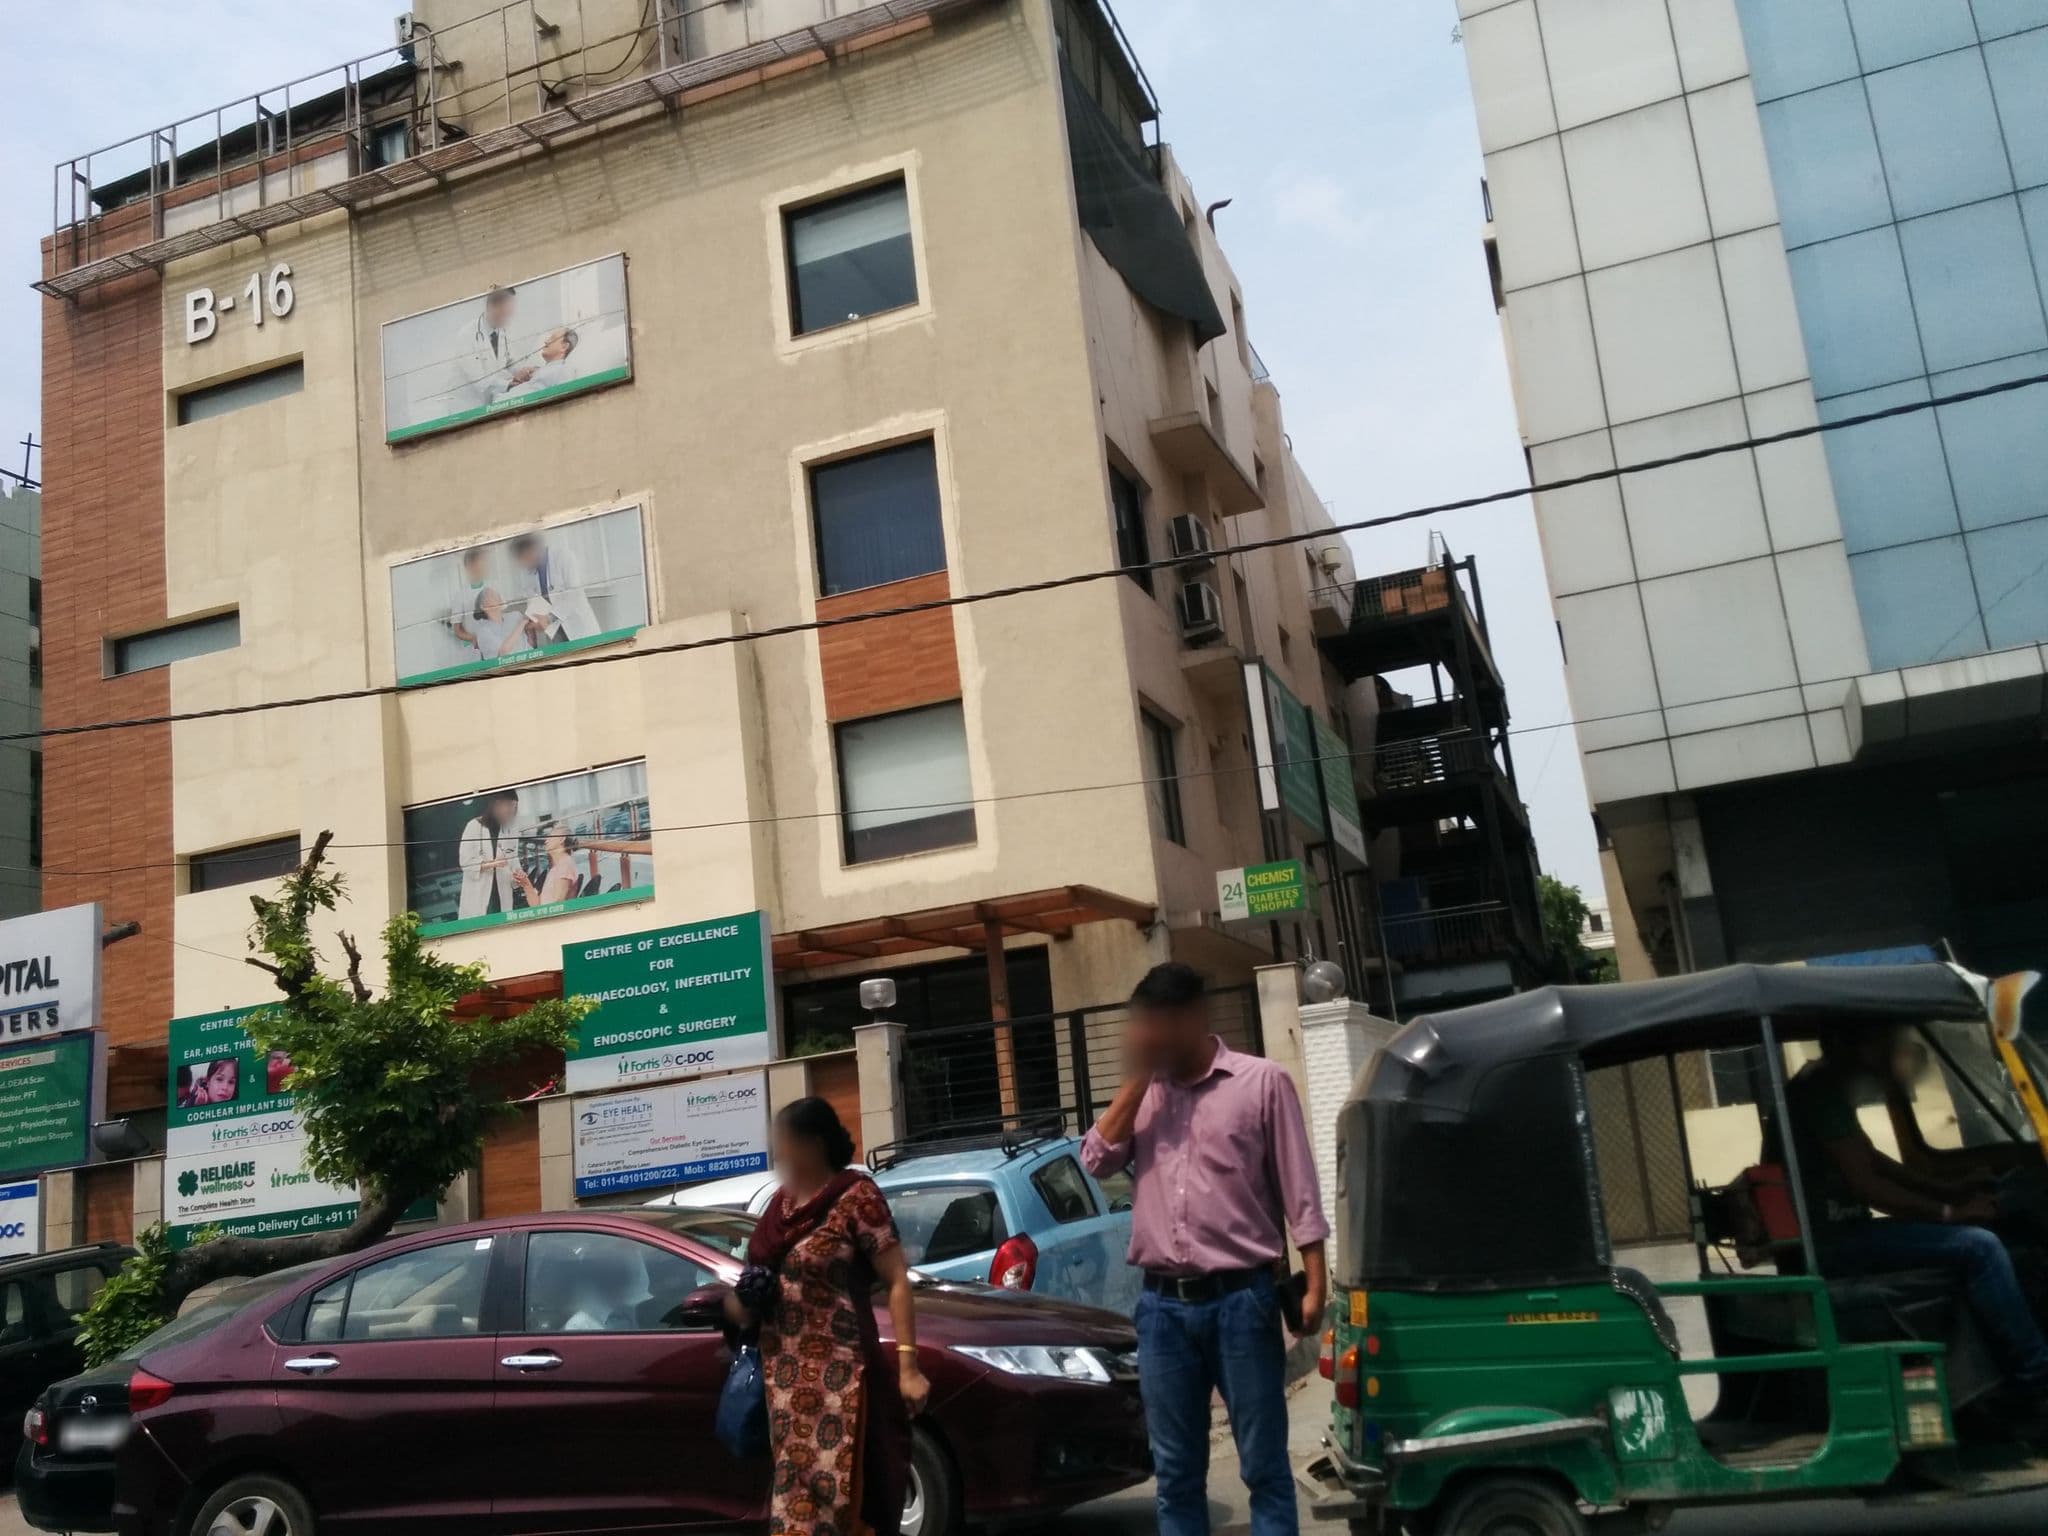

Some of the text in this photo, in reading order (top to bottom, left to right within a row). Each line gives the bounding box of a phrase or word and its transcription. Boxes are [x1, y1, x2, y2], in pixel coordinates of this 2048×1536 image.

[186, 263, 294, 344] B-16
[1247, 868, 1295, 887] CHEMIST
[1223, 882, 1243, 901] 24
[1249, 888, 1299, 905] DIABETES
[1254, 899, 1296, 913] SHOPPE
[584, 925, 739, 960] CENTRE OF EXCELLENCE
[650, 958, 674, 971] FOR
[675, 967, 751, 989] INFERTILITY
[659, 1003, 669, 1014] &
[200, 1018, 234, 1032] CENTRE
[593, 1015, 737, 1047] ENDOSCOPIC SURGERY
[184, 1049, 204, 1059] EAR,
[206, 1043, 232, 1055] NOSE,
[631, 1050, 714, 1071] Fortis C-DOC
[249, 1074, 256, 1083] &
[696, 1088, 757, 1104] Fortis C-DOC
[187, 1106, 234, 1123] COCHLEAR
[236, 1100, 274, 1114] IMPLANT
[603, 1103, 653, 1118] EYE HEALTH
[223, 1119, 295, 1140] Fortis C-DOC
[282, 1171, 310, 1187] Fortis
[584, 1156, 761, 1189] Tel: 011-49101200/222, Mob: 8826193120
[200, 1177, 243, 1195] wellness
[178, 1197, 256, 1213] The Complete Health Store
[227, 1224, 256, 1236] Home
[258, 1217, 299, 1232] Delivery
[301, 1213, 323, 1227] Call:
[325, 1210, 343, 1223] +91
